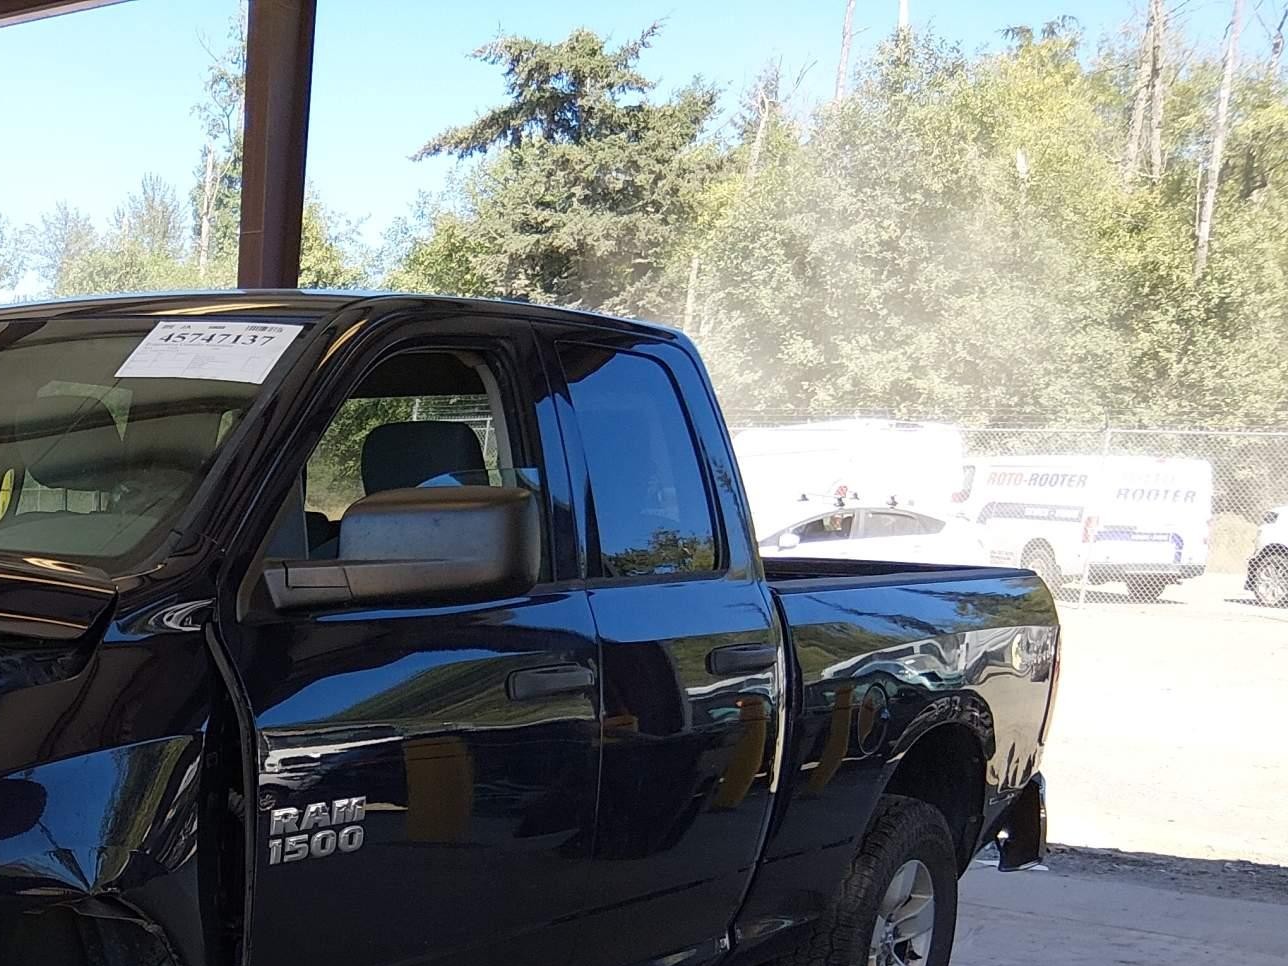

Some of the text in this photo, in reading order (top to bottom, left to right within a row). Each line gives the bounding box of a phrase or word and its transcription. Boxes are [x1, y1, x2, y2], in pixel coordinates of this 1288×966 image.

[160, 332, 275, 346] 45747137
[987, 471, 1088, 488] ROTO-ROOTER
[270, 796, 366, 836] RAM
[269, 825, 364, 865] 1500
